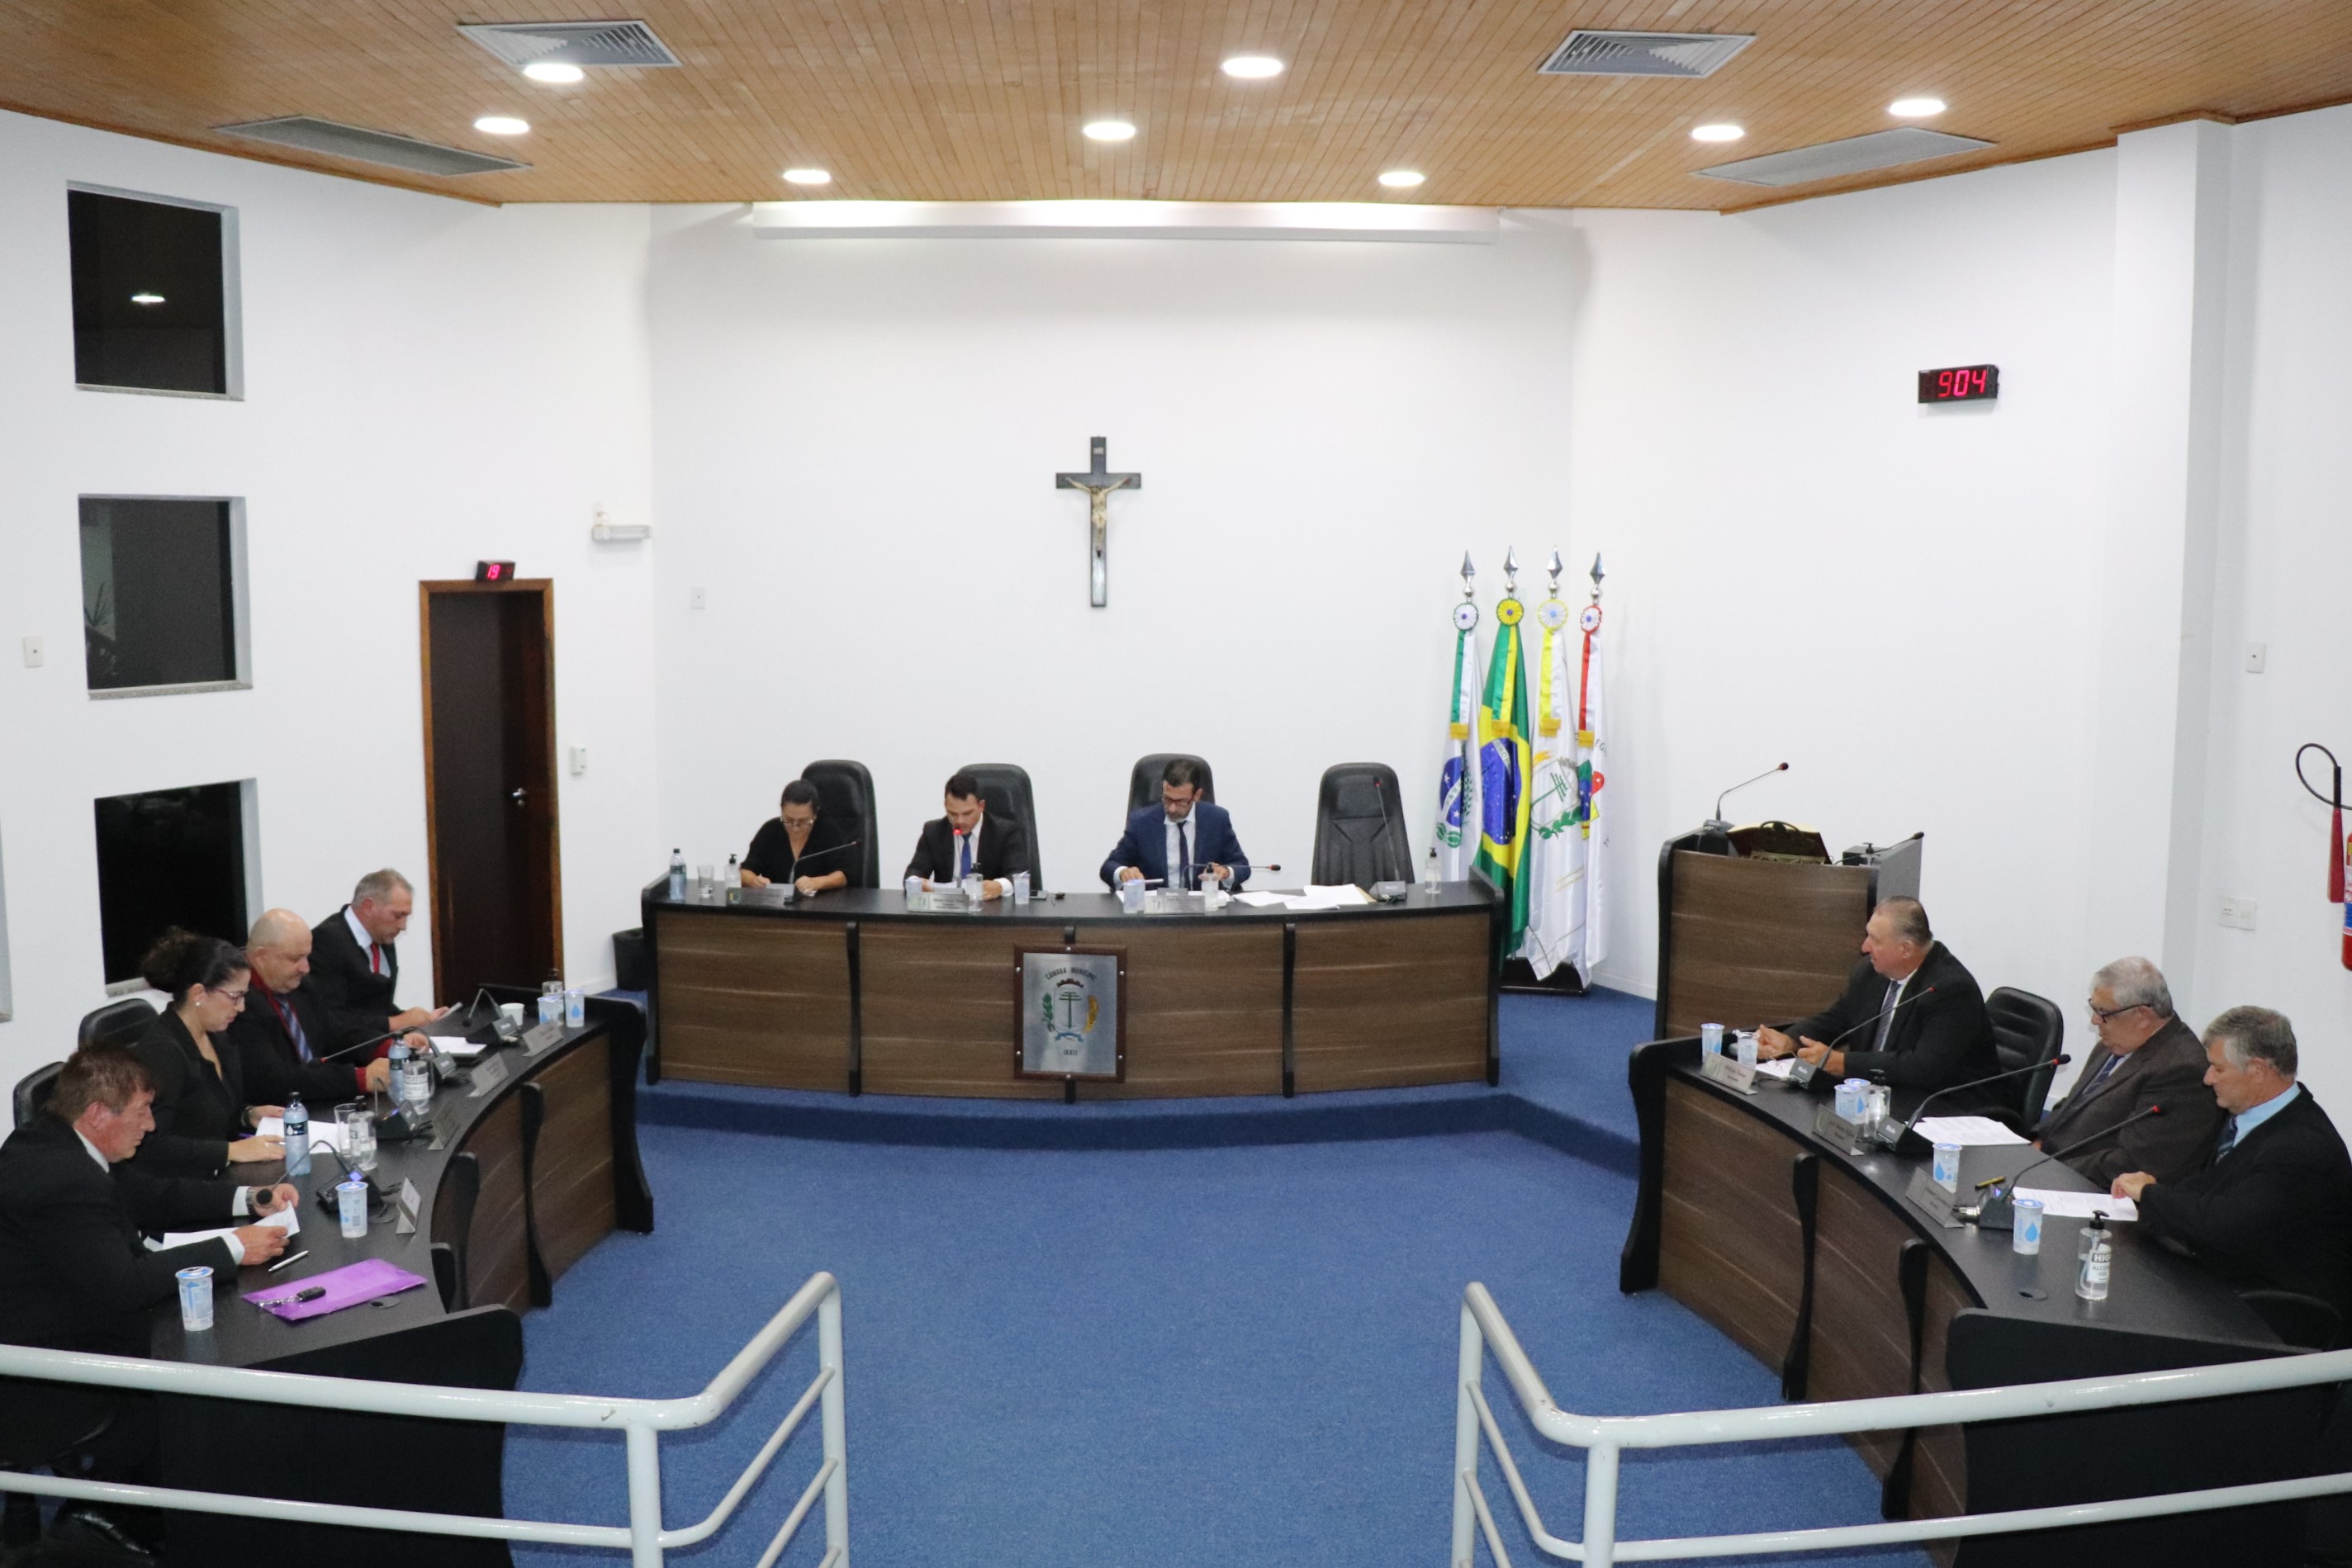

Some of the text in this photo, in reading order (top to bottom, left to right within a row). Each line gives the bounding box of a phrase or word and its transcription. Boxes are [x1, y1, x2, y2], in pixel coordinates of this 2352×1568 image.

[1937, 369, 1988, 397] 904
[1046, 967, 1097, 981] CÂMARA MUNICIPAL
